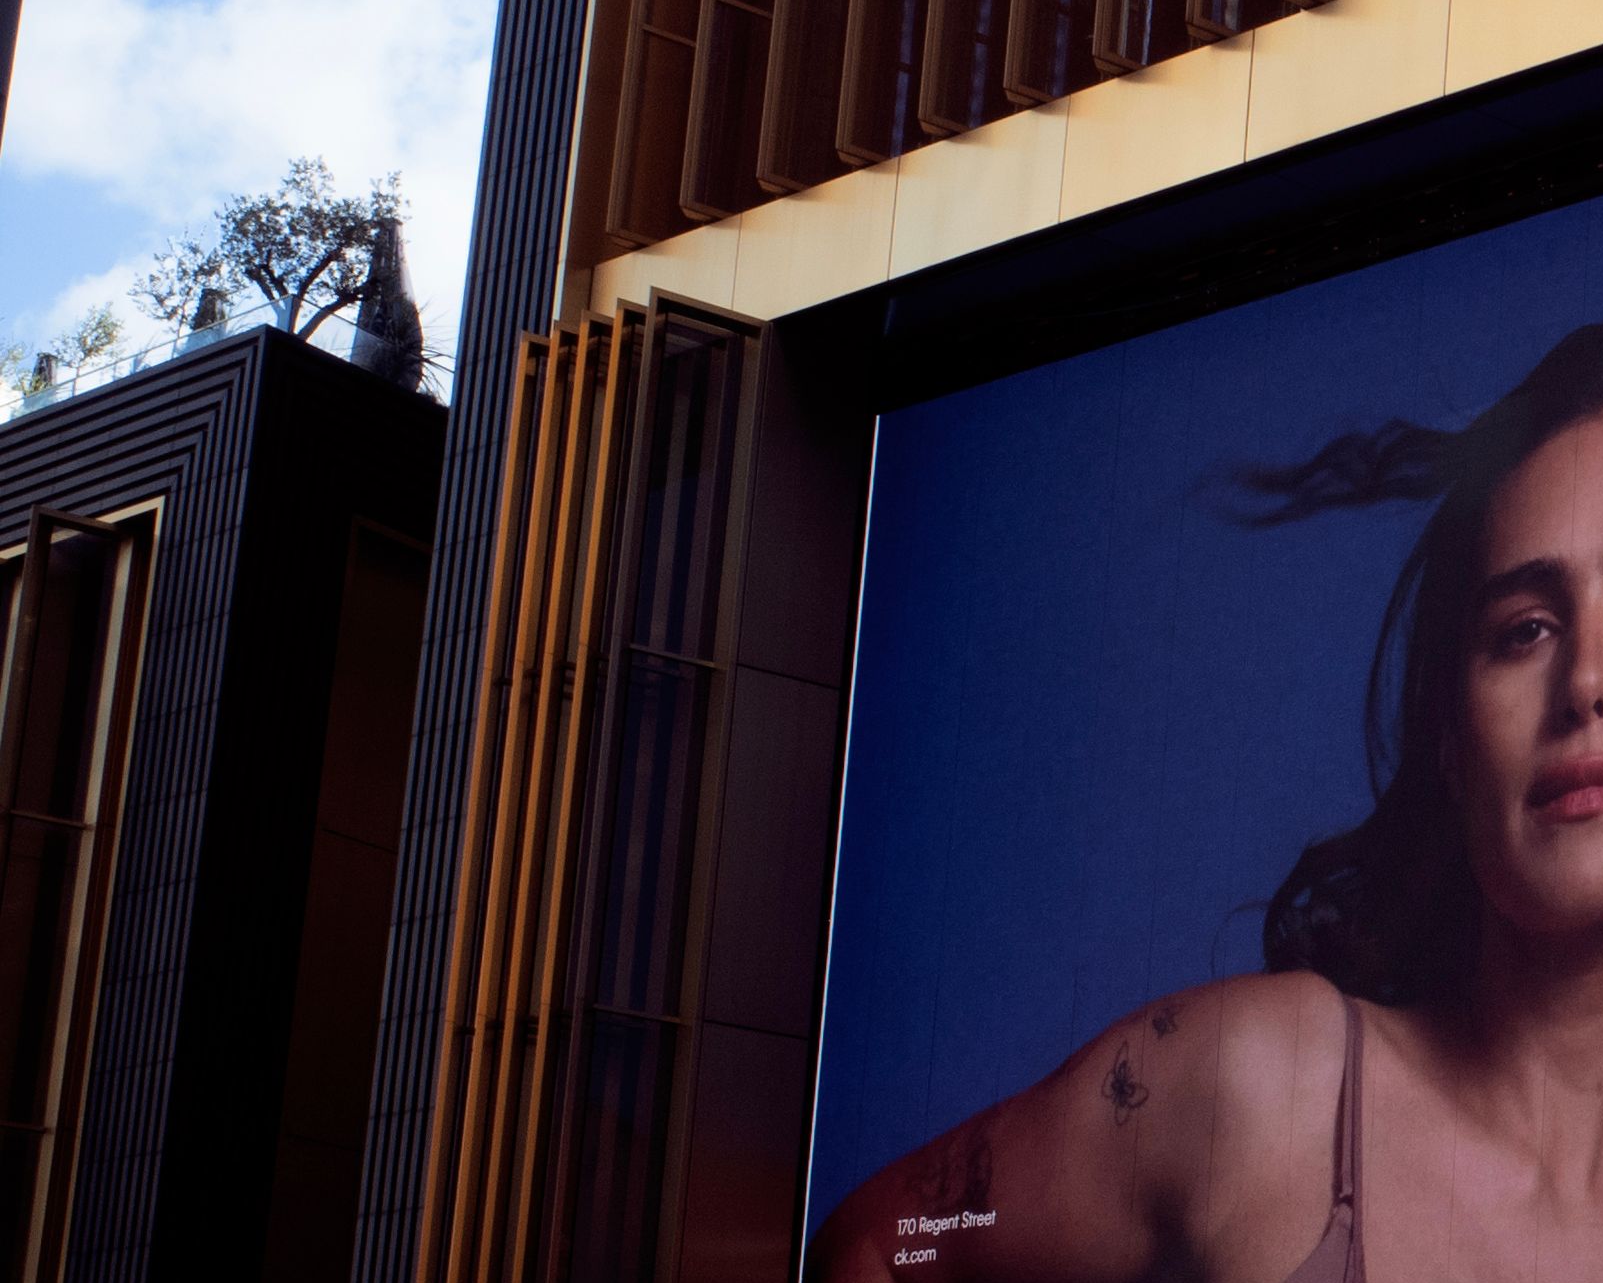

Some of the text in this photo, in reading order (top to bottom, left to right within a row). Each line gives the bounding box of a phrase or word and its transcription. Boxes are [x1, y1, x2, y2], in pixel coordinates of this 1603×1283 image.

[897, 1209, 997, 1236] 170 Regent Street
[894, 1247, 937, 1266] ck.com
